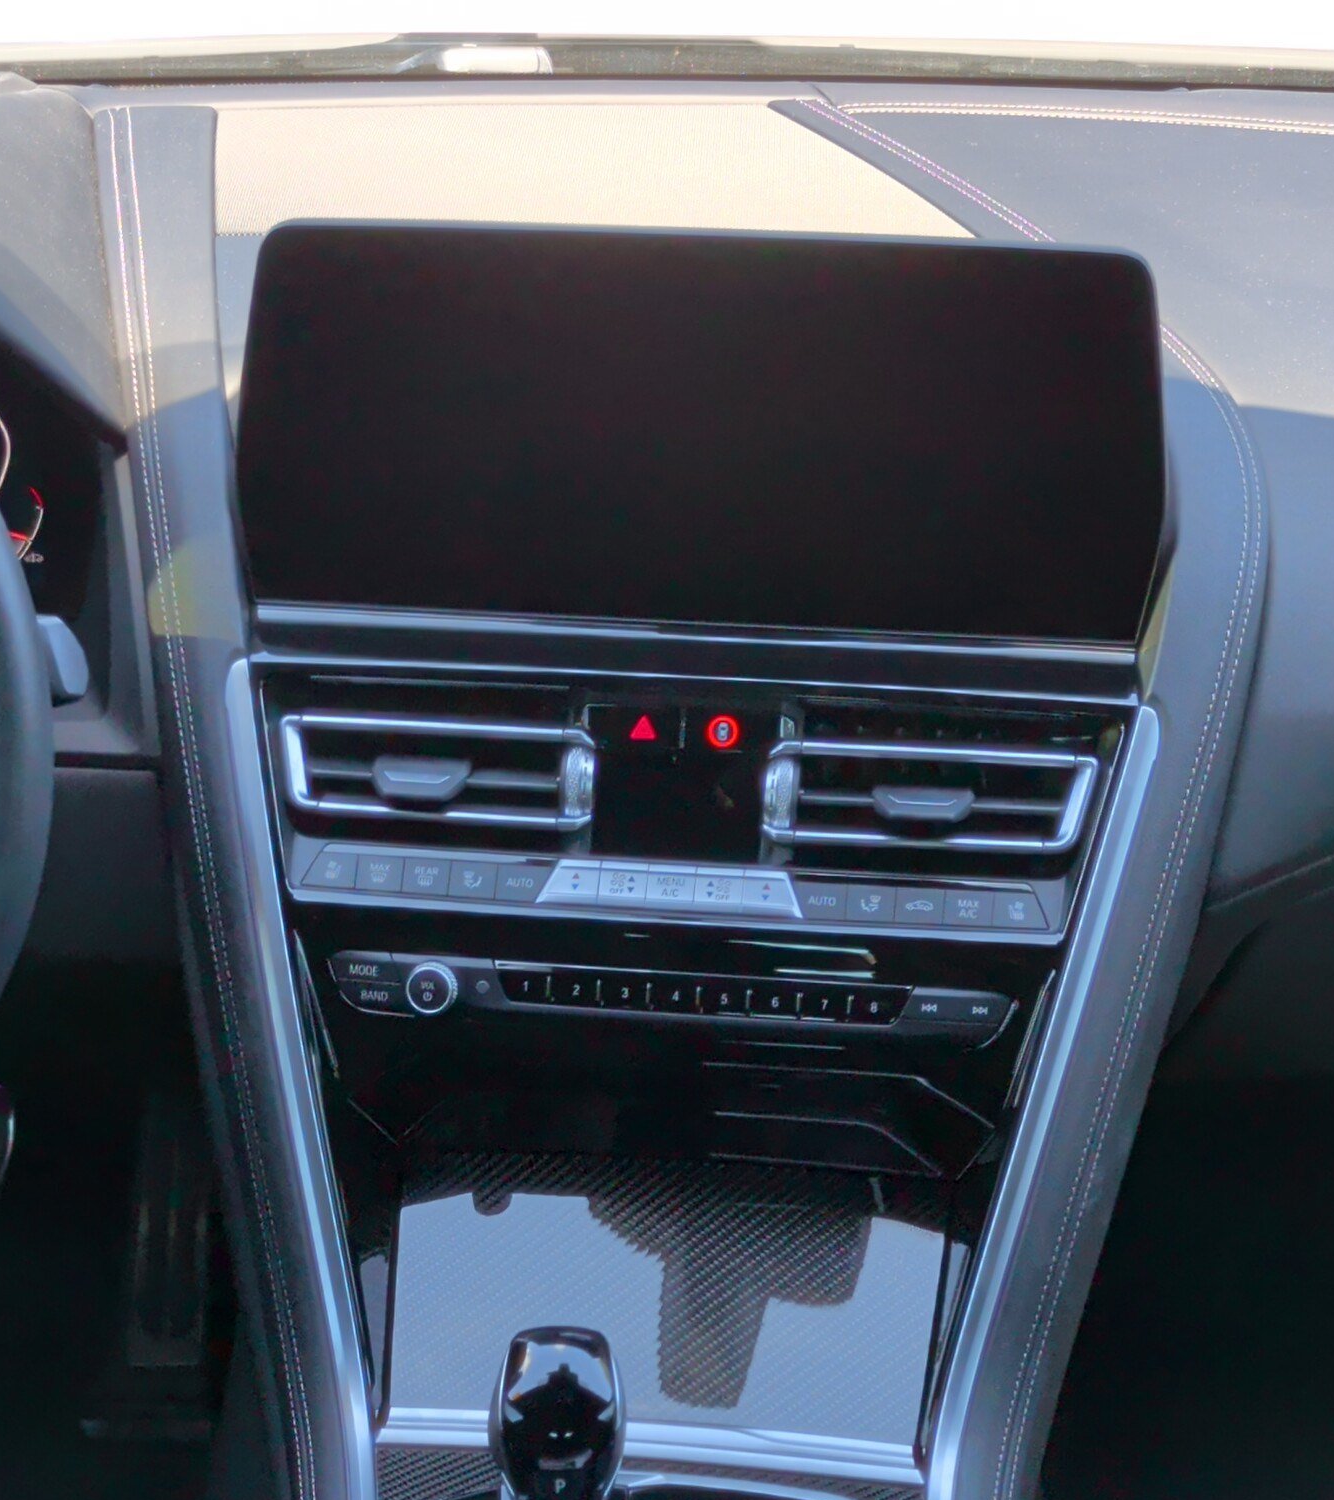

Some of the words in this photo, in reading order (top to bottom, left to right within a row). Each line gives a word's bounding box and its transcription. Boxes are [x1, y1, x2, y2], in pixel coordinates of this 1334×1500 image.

[370, 863, 391, 872] MAX
[415, 866, 440, 876] REAR
[506, 877, 534, 888] AUTO
[656, 877, 686, 887] MENU
[661, 888, 680, 898] A/C
[808, 895, 836, 907] AUTO
[957, 899, 980, 909] MAX
[958, 909, 978, 919] A/C
[349, 964, 380, 977] MODE
[420, 982, 435, 990] VOL
[522, 981, 529, 991] 1
[572, 984, 581, 996] 2
[360, 990, 389, 1002] BAND
[621, 988, 630, 998] 3
[672, 990, 680, 1001] 4
[720, 993, 728, 1004] 5
[771, 997, 779, 1008] 6
[821, 999, 829, 1010] 7
[870, 1002, 878, 1013] 8
[555, 1479, 566, 1494] P
